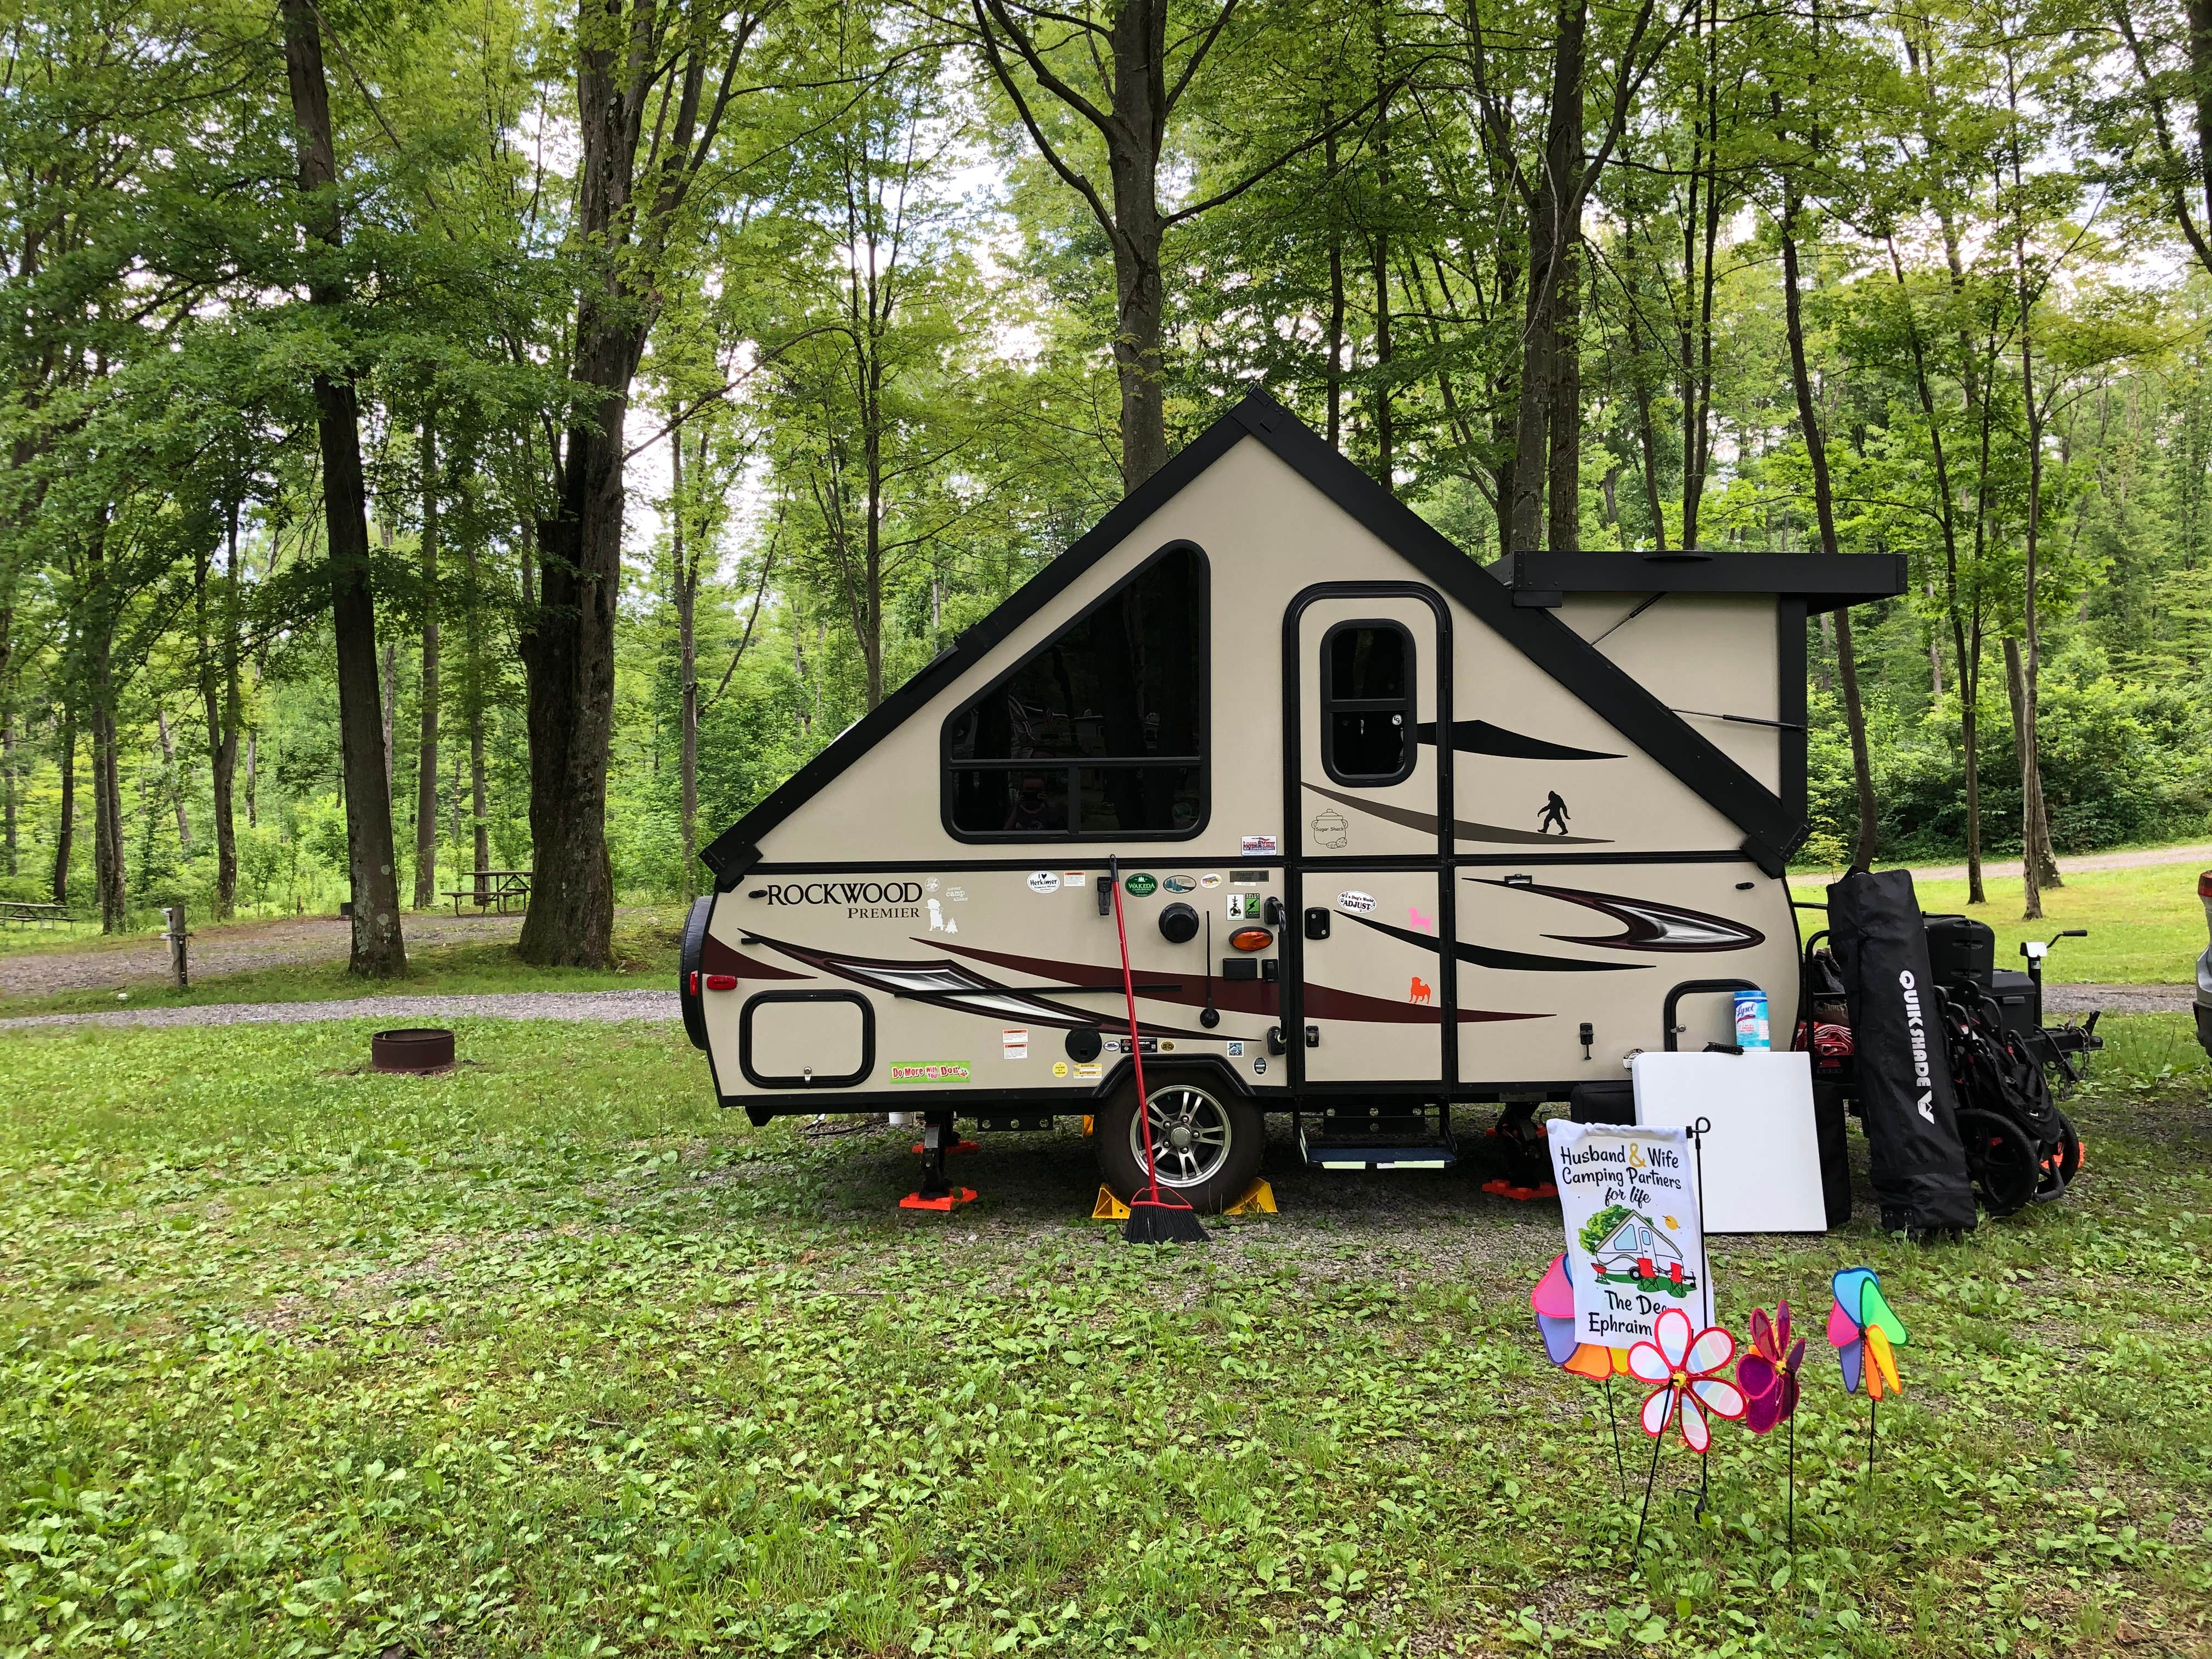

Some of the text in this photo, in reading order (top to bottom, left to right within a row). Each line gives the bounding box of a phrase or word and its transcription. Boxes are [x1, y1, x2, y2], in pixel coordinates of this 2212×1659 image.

[767, 882, 923, 905] ROCKWOOD
[1343, 900, 1370, 910] ADJUST
[847, 907, 920, 918] PREMIER
[1737, 1003, 1755, 1017] Lysol
[893, 1068, 904, 1077] Do
[905, 1068, 924, 1077] More
[1561, 1143, 1679, 1168] Husband & Wife
[1562, 1166, 1681, 1189] Camping Partners
[1605, 1186, 1651, 1209] for life
[1604, 1290, 1682, 1315] The Dea
[1588, 1312, 1652, 1336] Ephraim
